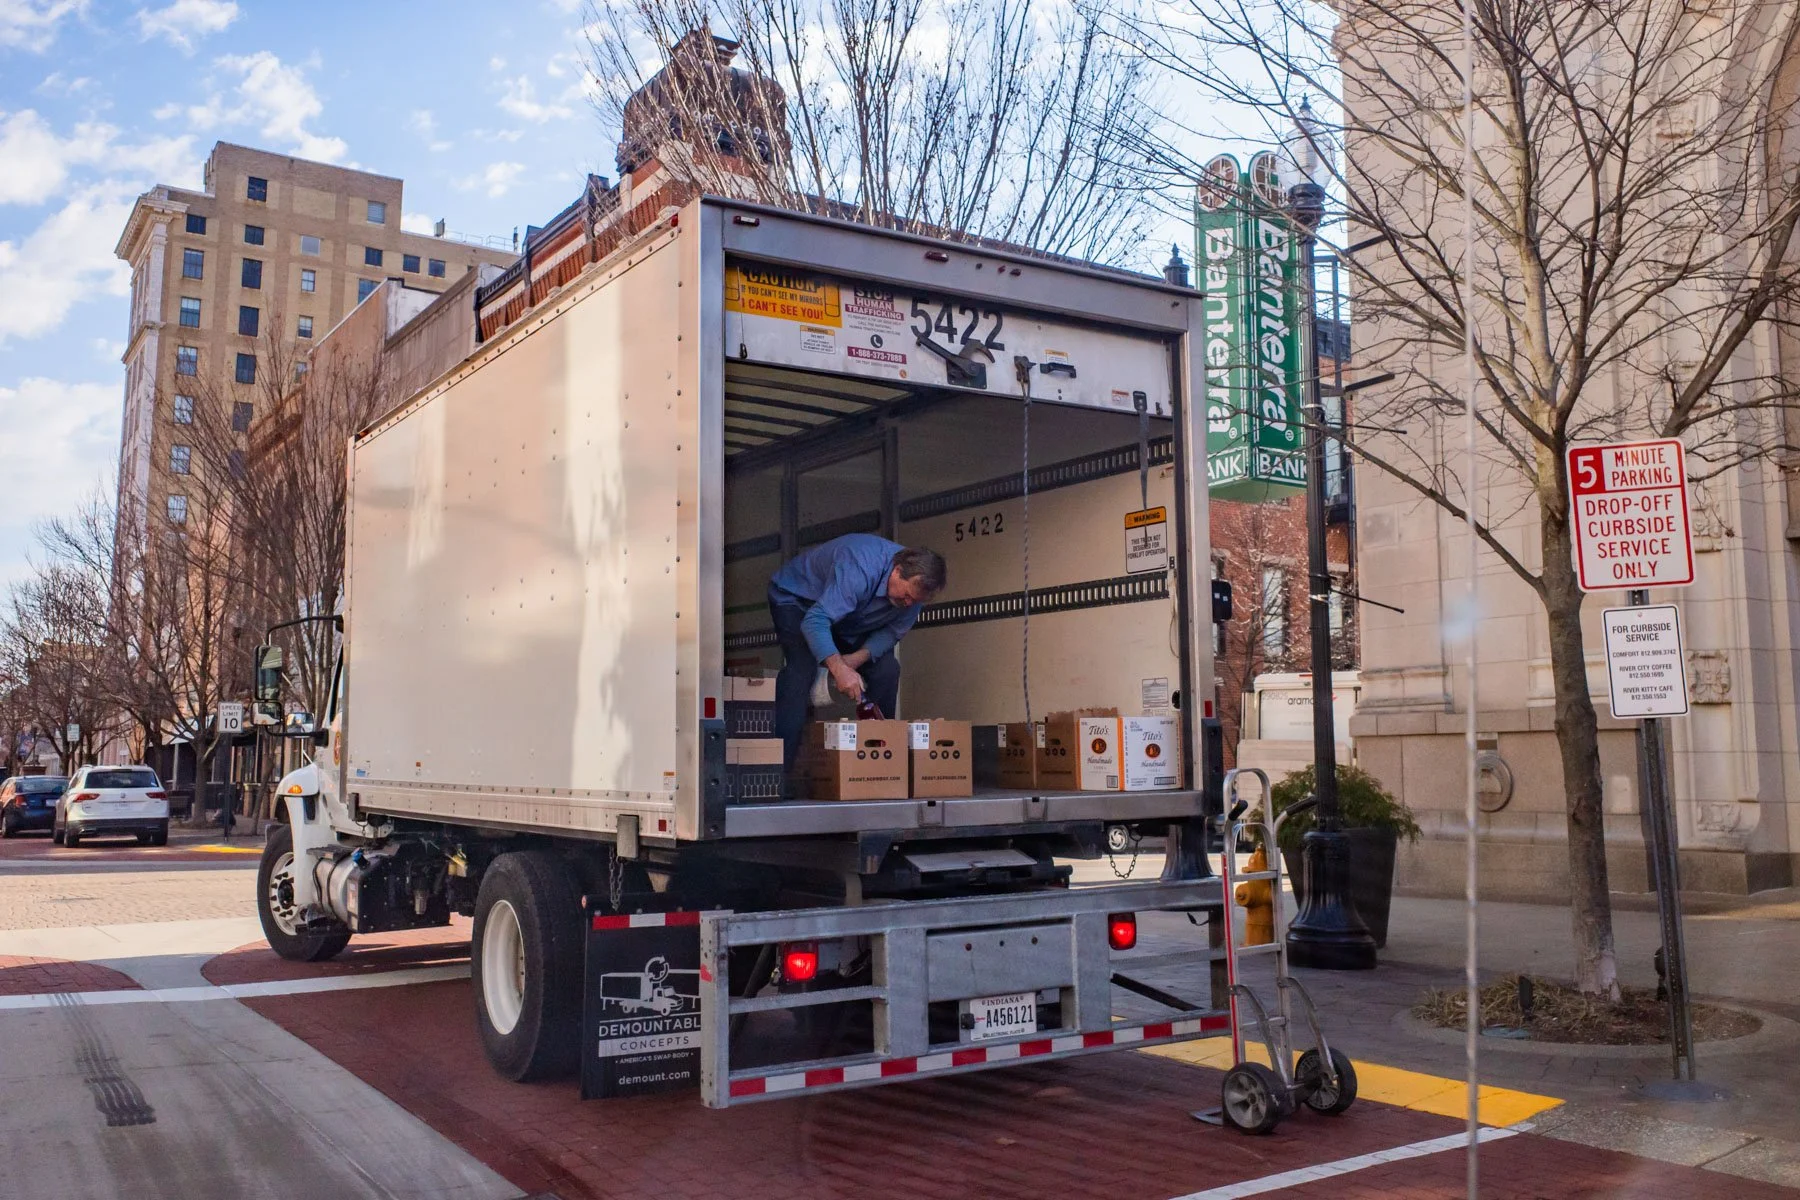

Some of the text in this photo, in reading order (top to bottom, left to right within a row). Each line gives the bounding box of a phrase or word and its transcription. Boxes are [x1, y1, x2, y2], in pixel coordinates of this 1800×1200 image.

[748, 286, 759, 295] YOU
[778, 291, 788, 300] SEE
[741, 298, 824, 320] I CAN'T SEE YOU!
[848, 305, 902, 320] TRAFFICKING
[856, 297, 893, 311] HUMAN
[910, 298, 1005, 351] 5422
[1204, 227, 1235, 435] Banterra
[1257, 217, 1292, 433] Banterra
[1207, 453, 1242, 479] ANK
[1259, 453, 1307, 479] BANK
[1614, 447, 1666, 468] MINUTE
[1577, 455, 1597, 489] 5
[1611, 467, 1672, 488] PARKING
[1585, 493, 1673, 516] DROP-OFF
[955, 512, 1004, 543] 5422
[1588, 516, 1676, 537] CURBSIDE
[1133, 543, 1150, 551] DESIGED
[1597, 538, 1671, 559] SERVICE
[1613, 561, 1658, 580] ONLY
[1612, 623, 1671, 634] FOR CURBSIDE
[1625, 633, 1660, 643] SERVICE
[1287, 696, 1315, 705] arama
[224, 718, 238, 729] 10
[1088, 725, 1110, 736] Tito's
[1142, 731, 1163, 741] Tito's
[1087, 756, 1113, 765] Handmade
[1141, 760, 1167, 769] Handmade
[987, 997, 1020, 1006] INDIANA
[986, 1004, 1034, 1028] A456121
[599, 1017, 701, 1037] DEMOUNTABL
[620, 1036, 690, 1051] CONCEPTS
[619, 1055, 652, 1064] AMERICA'S
[653, 1053, 671, 1061] SWAP
[618, 1070, 690, 1085] demount.com
